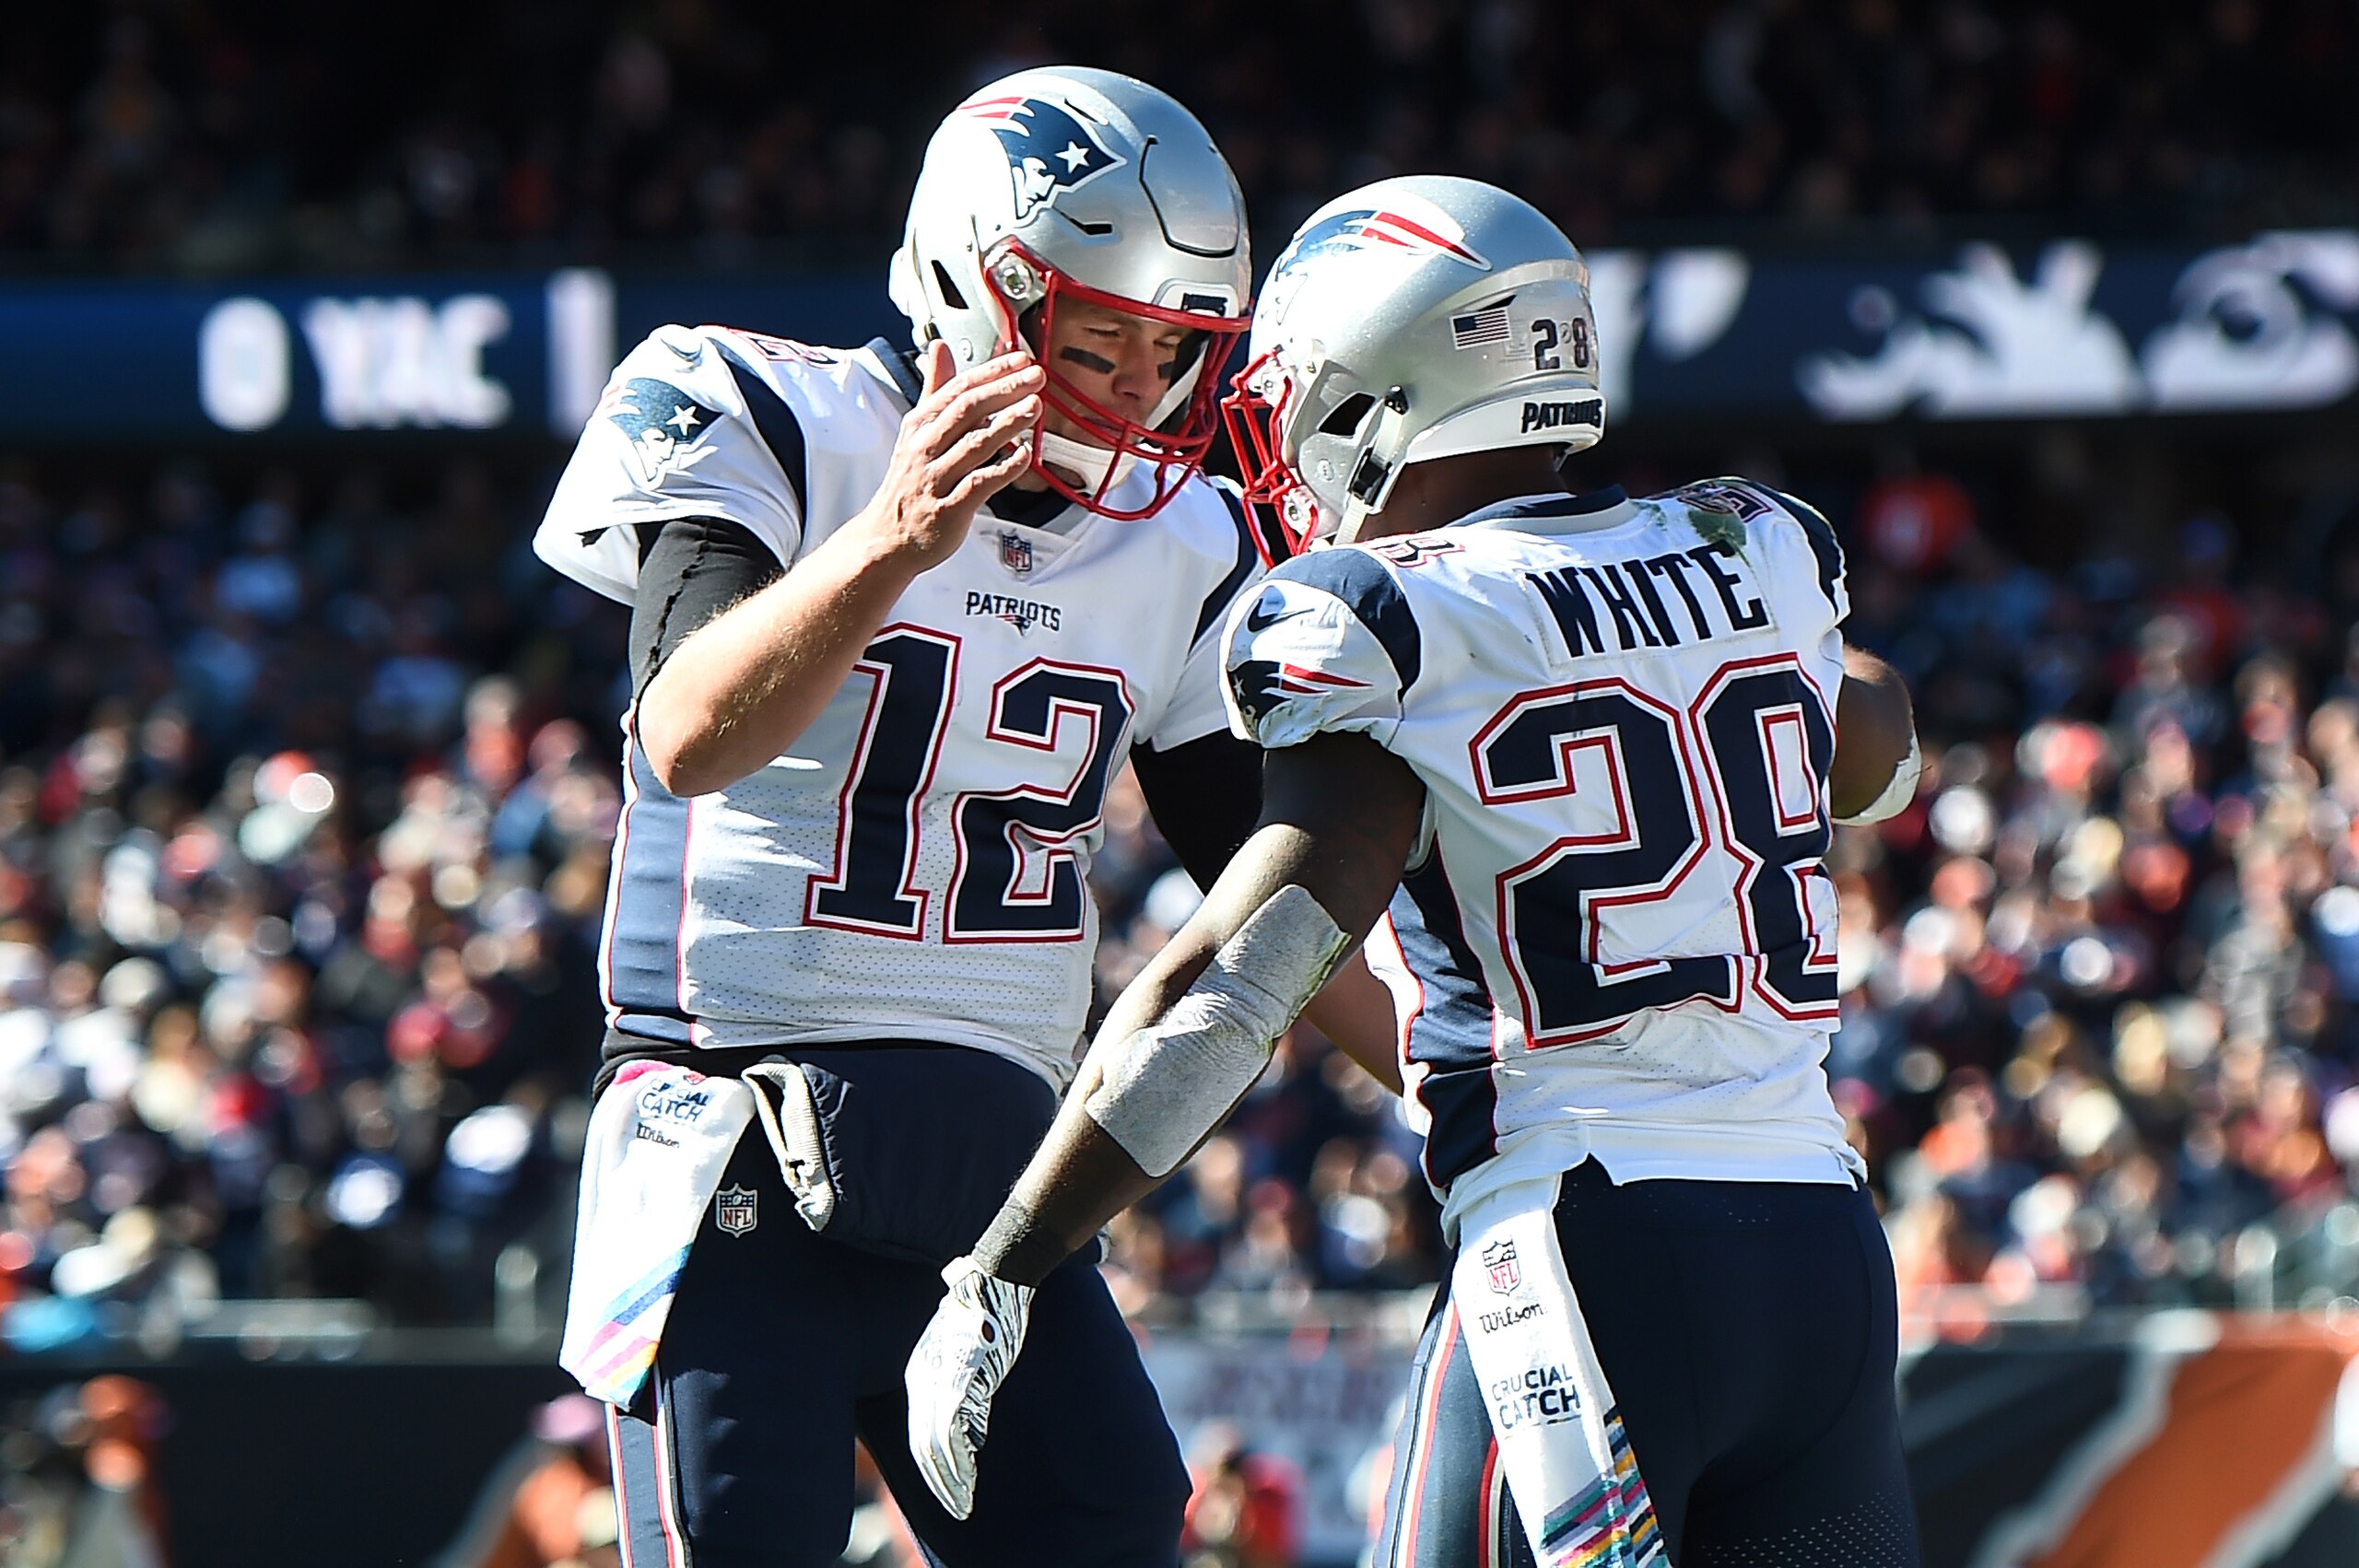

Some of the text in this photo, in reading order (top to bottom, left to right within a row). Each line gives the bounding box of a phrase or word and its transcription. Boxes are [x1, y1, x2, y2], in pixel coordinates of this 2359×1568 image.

[1531, 317, 1590, 370] 28
[1005, 546, 1030, 568] NFL
[966, 591, 1062, 632] PATRIOTS
[1525, 544, 1763, 658] WHITE
[803, 621, 1136, 944] 12
[1468, 651, 1839, 1051] 28
[642, 1092, 703, 1123] CATCH
[651, 1077, 710, 1106] CRCIAL
[722, 1208, 752, 1228] NFL
[1489, 1262, 1519, 1290] NFL
[1479, 1303, 1544, 1334] Wilson
[1492, 1363, 1573, 1402] CRUCIAL
[1499, 1384, 1581, 1430] CATCH
